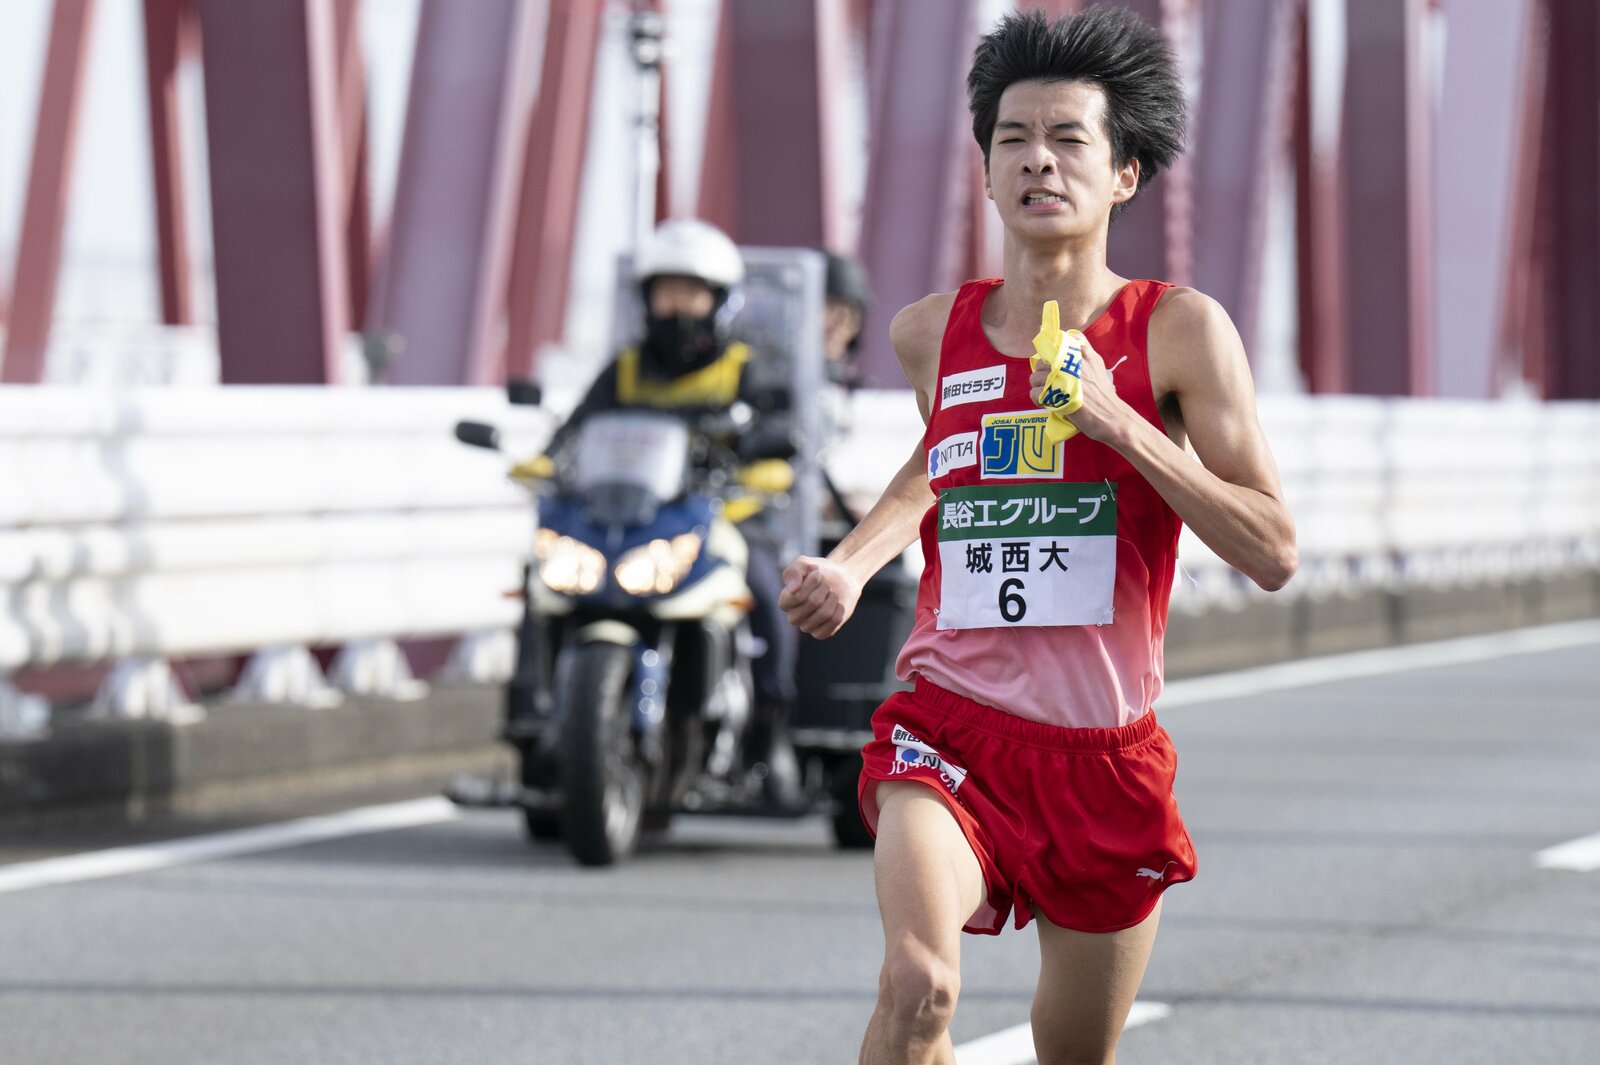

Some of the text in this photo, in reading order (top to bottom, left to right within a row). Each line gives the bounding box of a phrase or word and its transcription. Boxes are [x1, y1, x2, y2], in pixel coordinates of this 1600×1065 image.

[943, 376, 1005, 400] 新田ゼラチン
[1014, 416, 1049, 424] UNIVERSI
[941, 440, 974, 466] NITTA
[985, 425, 1055, 473] JU
[966, 540, 1070, 574] 城西大
[998, 577, 1027, 623] 6
